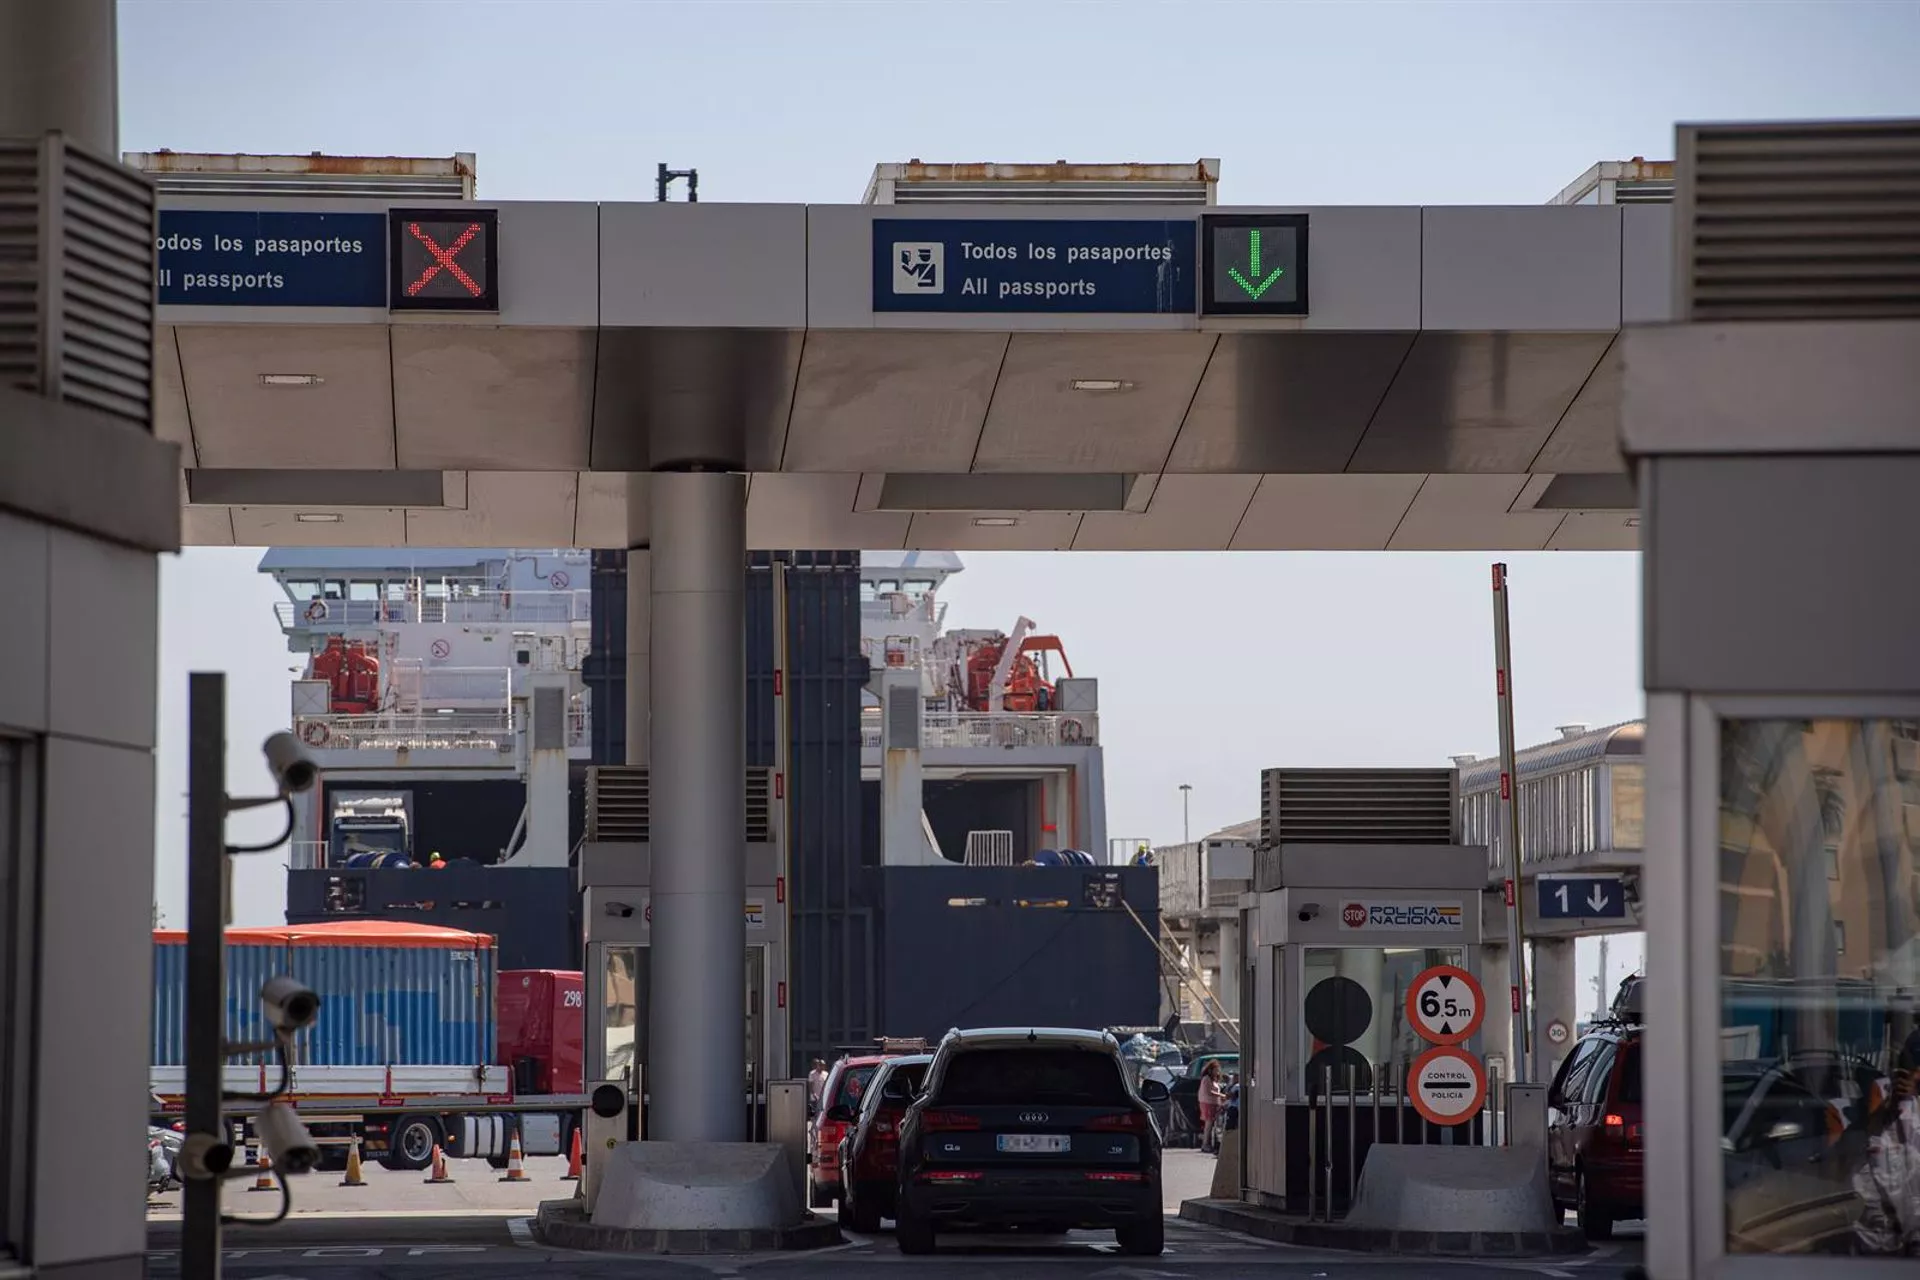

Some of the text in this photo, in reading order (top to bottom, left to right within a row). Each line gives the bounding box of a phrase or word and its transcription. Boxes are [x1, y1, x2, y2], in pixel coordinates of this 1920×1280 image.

[156, 233, 363, 256] odos los pasaportes
[961, 242, 1172, 264] Todos los pasaportes
[156, 269, 284, 292] ll passports
[961, 277, 1096, 299] All passports
[1554, 885, 1568, 912] 1
[1344, 910, 1366, 921] STOP
[1370, 906, 1439, 916] POLICIA
[1370, 916, 1461, 925] NACIONAL
[563, 990, 582, 1008] 298
